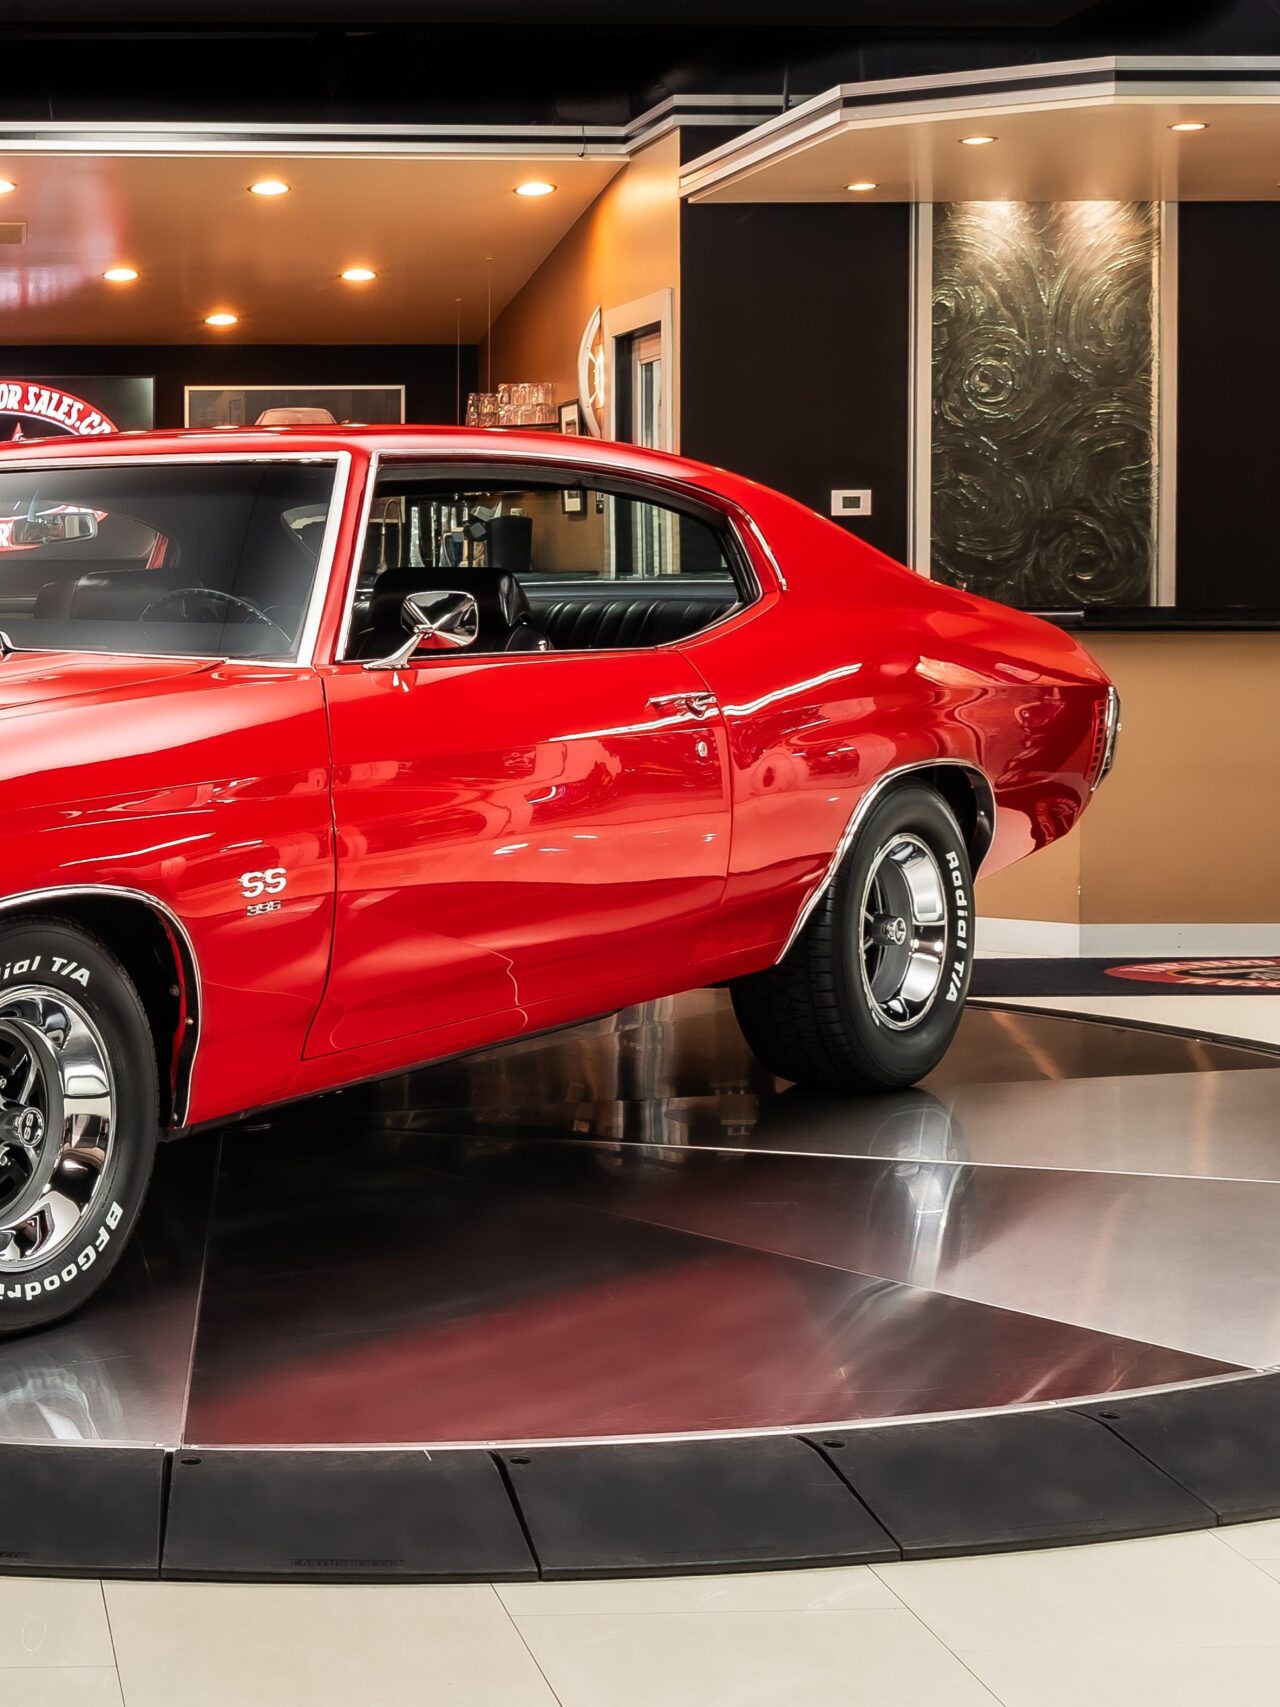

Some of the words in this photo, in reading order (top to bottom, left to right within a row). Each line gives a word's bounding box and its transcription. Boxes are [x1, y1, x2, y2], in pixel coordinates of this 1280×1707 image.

[239, 866, 287, 898] SS
[945, 850, 969, 950] Radial
[51, 957, 91, 987] T/A
[945, 960, 965, 1002] T/A
